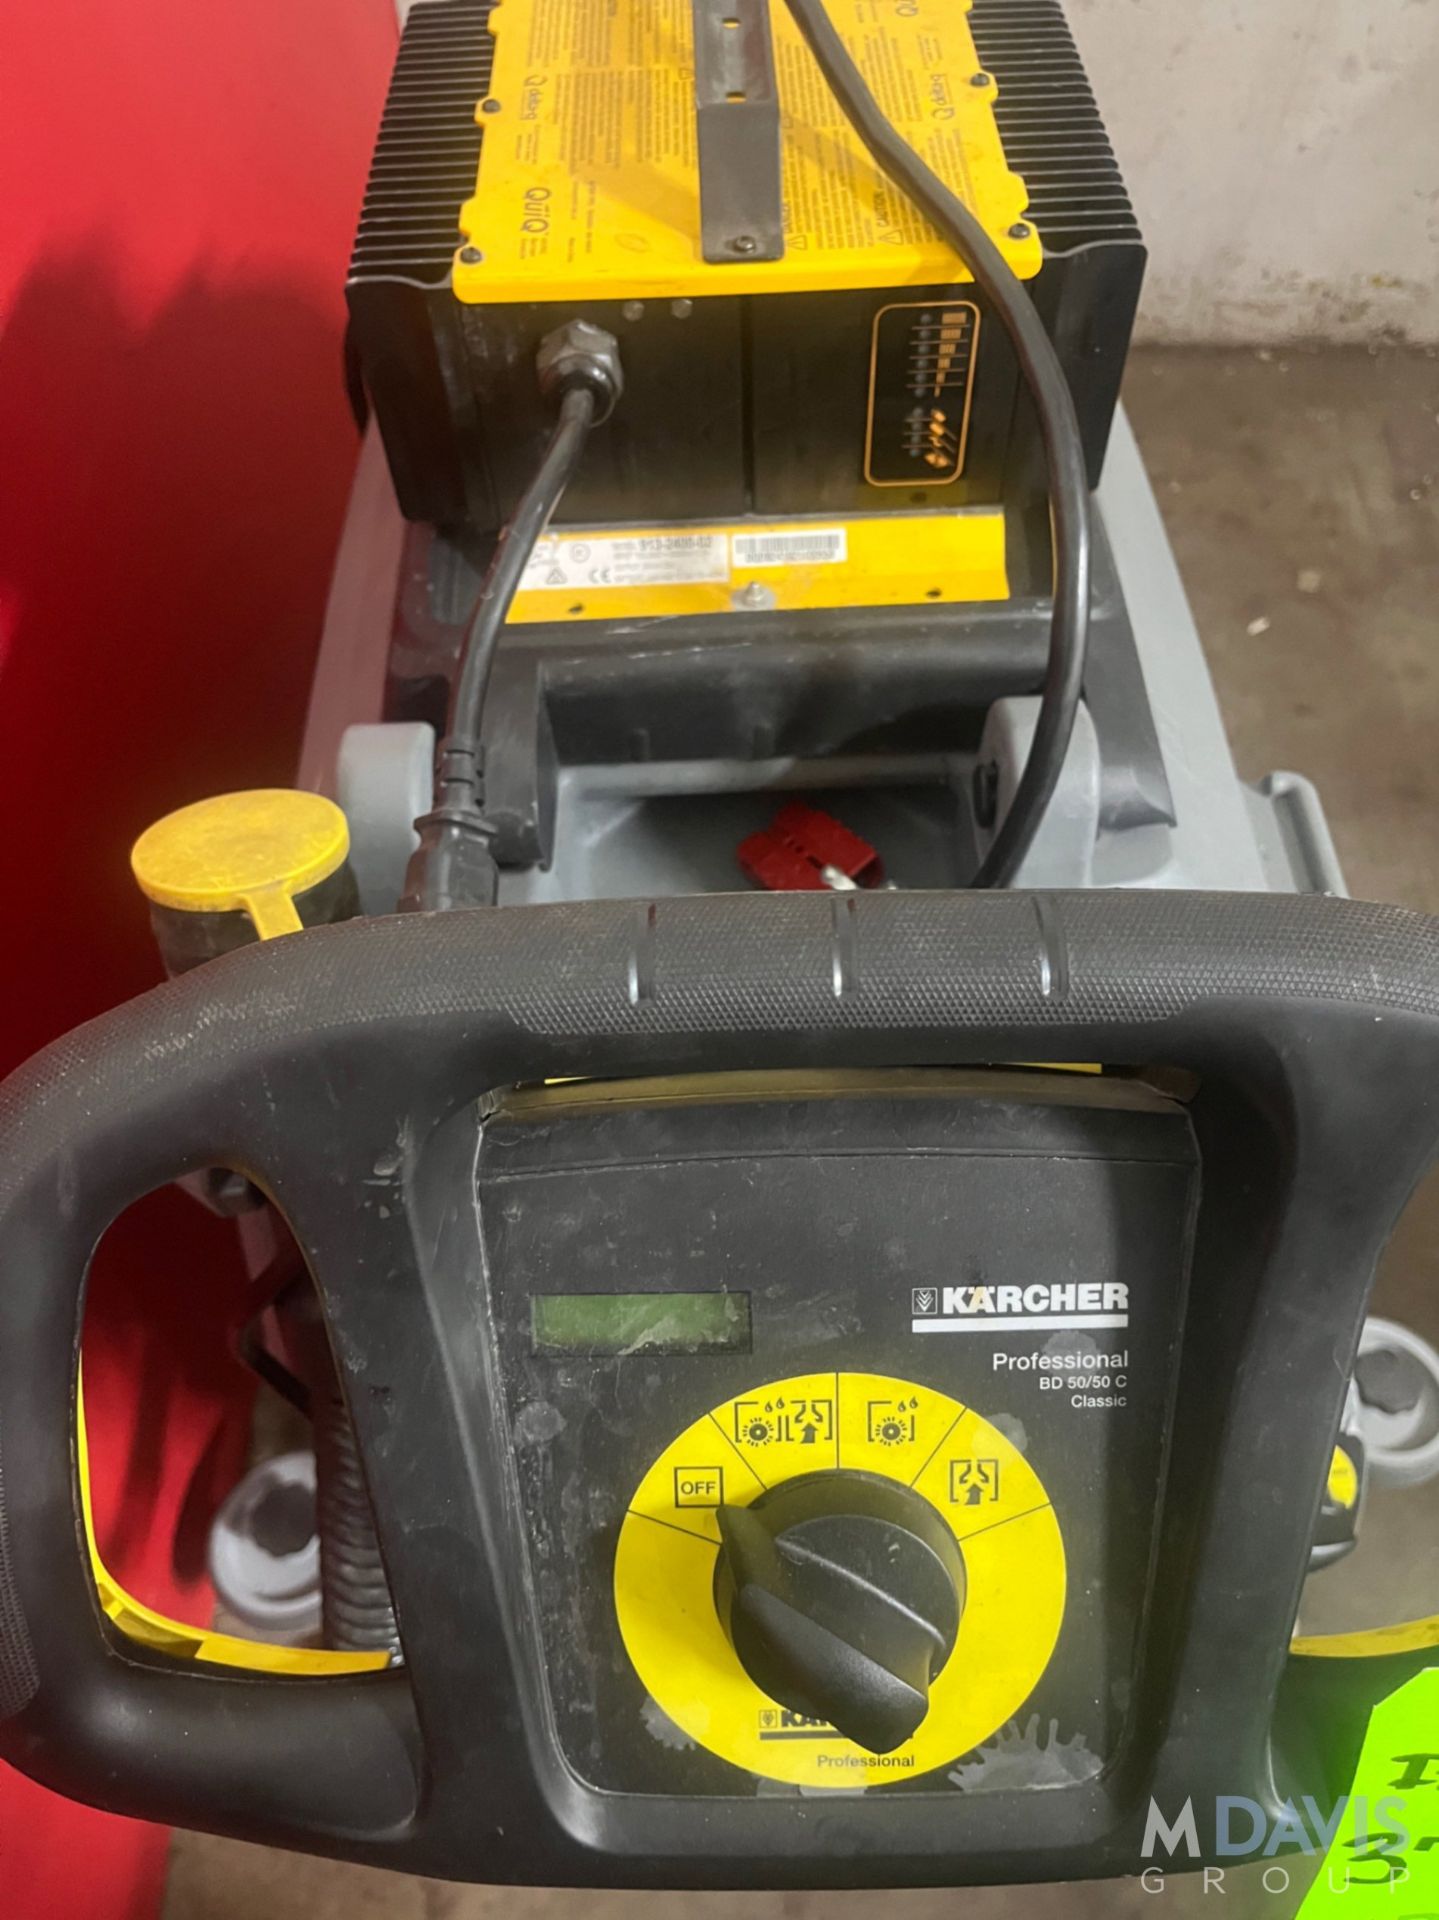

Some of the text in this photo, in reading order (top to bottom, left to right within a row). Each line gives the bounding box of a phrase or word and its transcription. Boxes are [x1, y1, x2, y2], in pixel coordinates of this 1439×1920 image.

[943, 1282, 1129, 1314] KÄRCHER
[992, 1350, 1129, 1371] Professional
[1039, 1375, 1128, 1390] BD 50/50 C
[1071, 1394, 1128, 1409] Classic
[680, 1481, 716, 1495] OFF
[817, 1754, 915, 1768] Professional
